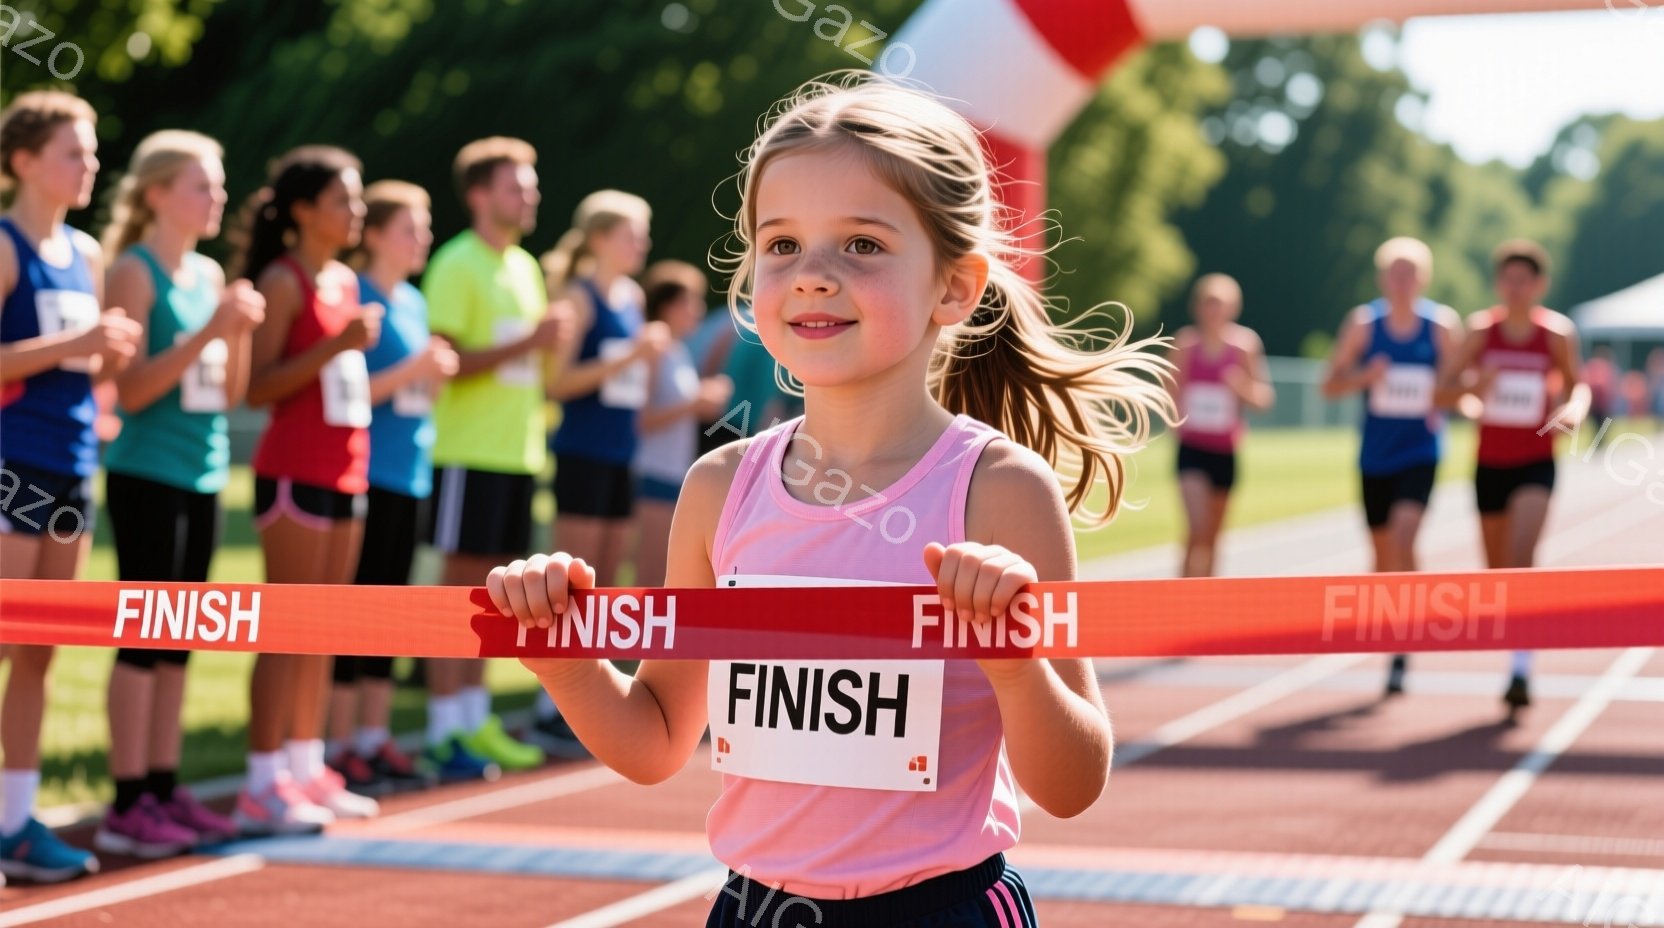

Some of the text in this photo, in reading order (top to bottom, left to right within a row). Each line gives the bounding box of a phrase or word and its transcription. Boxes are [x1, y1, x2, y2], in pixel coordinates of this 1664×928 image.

[113, 589, 261, 642] FINISH
[1322, 582, 1507, 642] FINISH
[728, 662, 909, 738] FINISH
